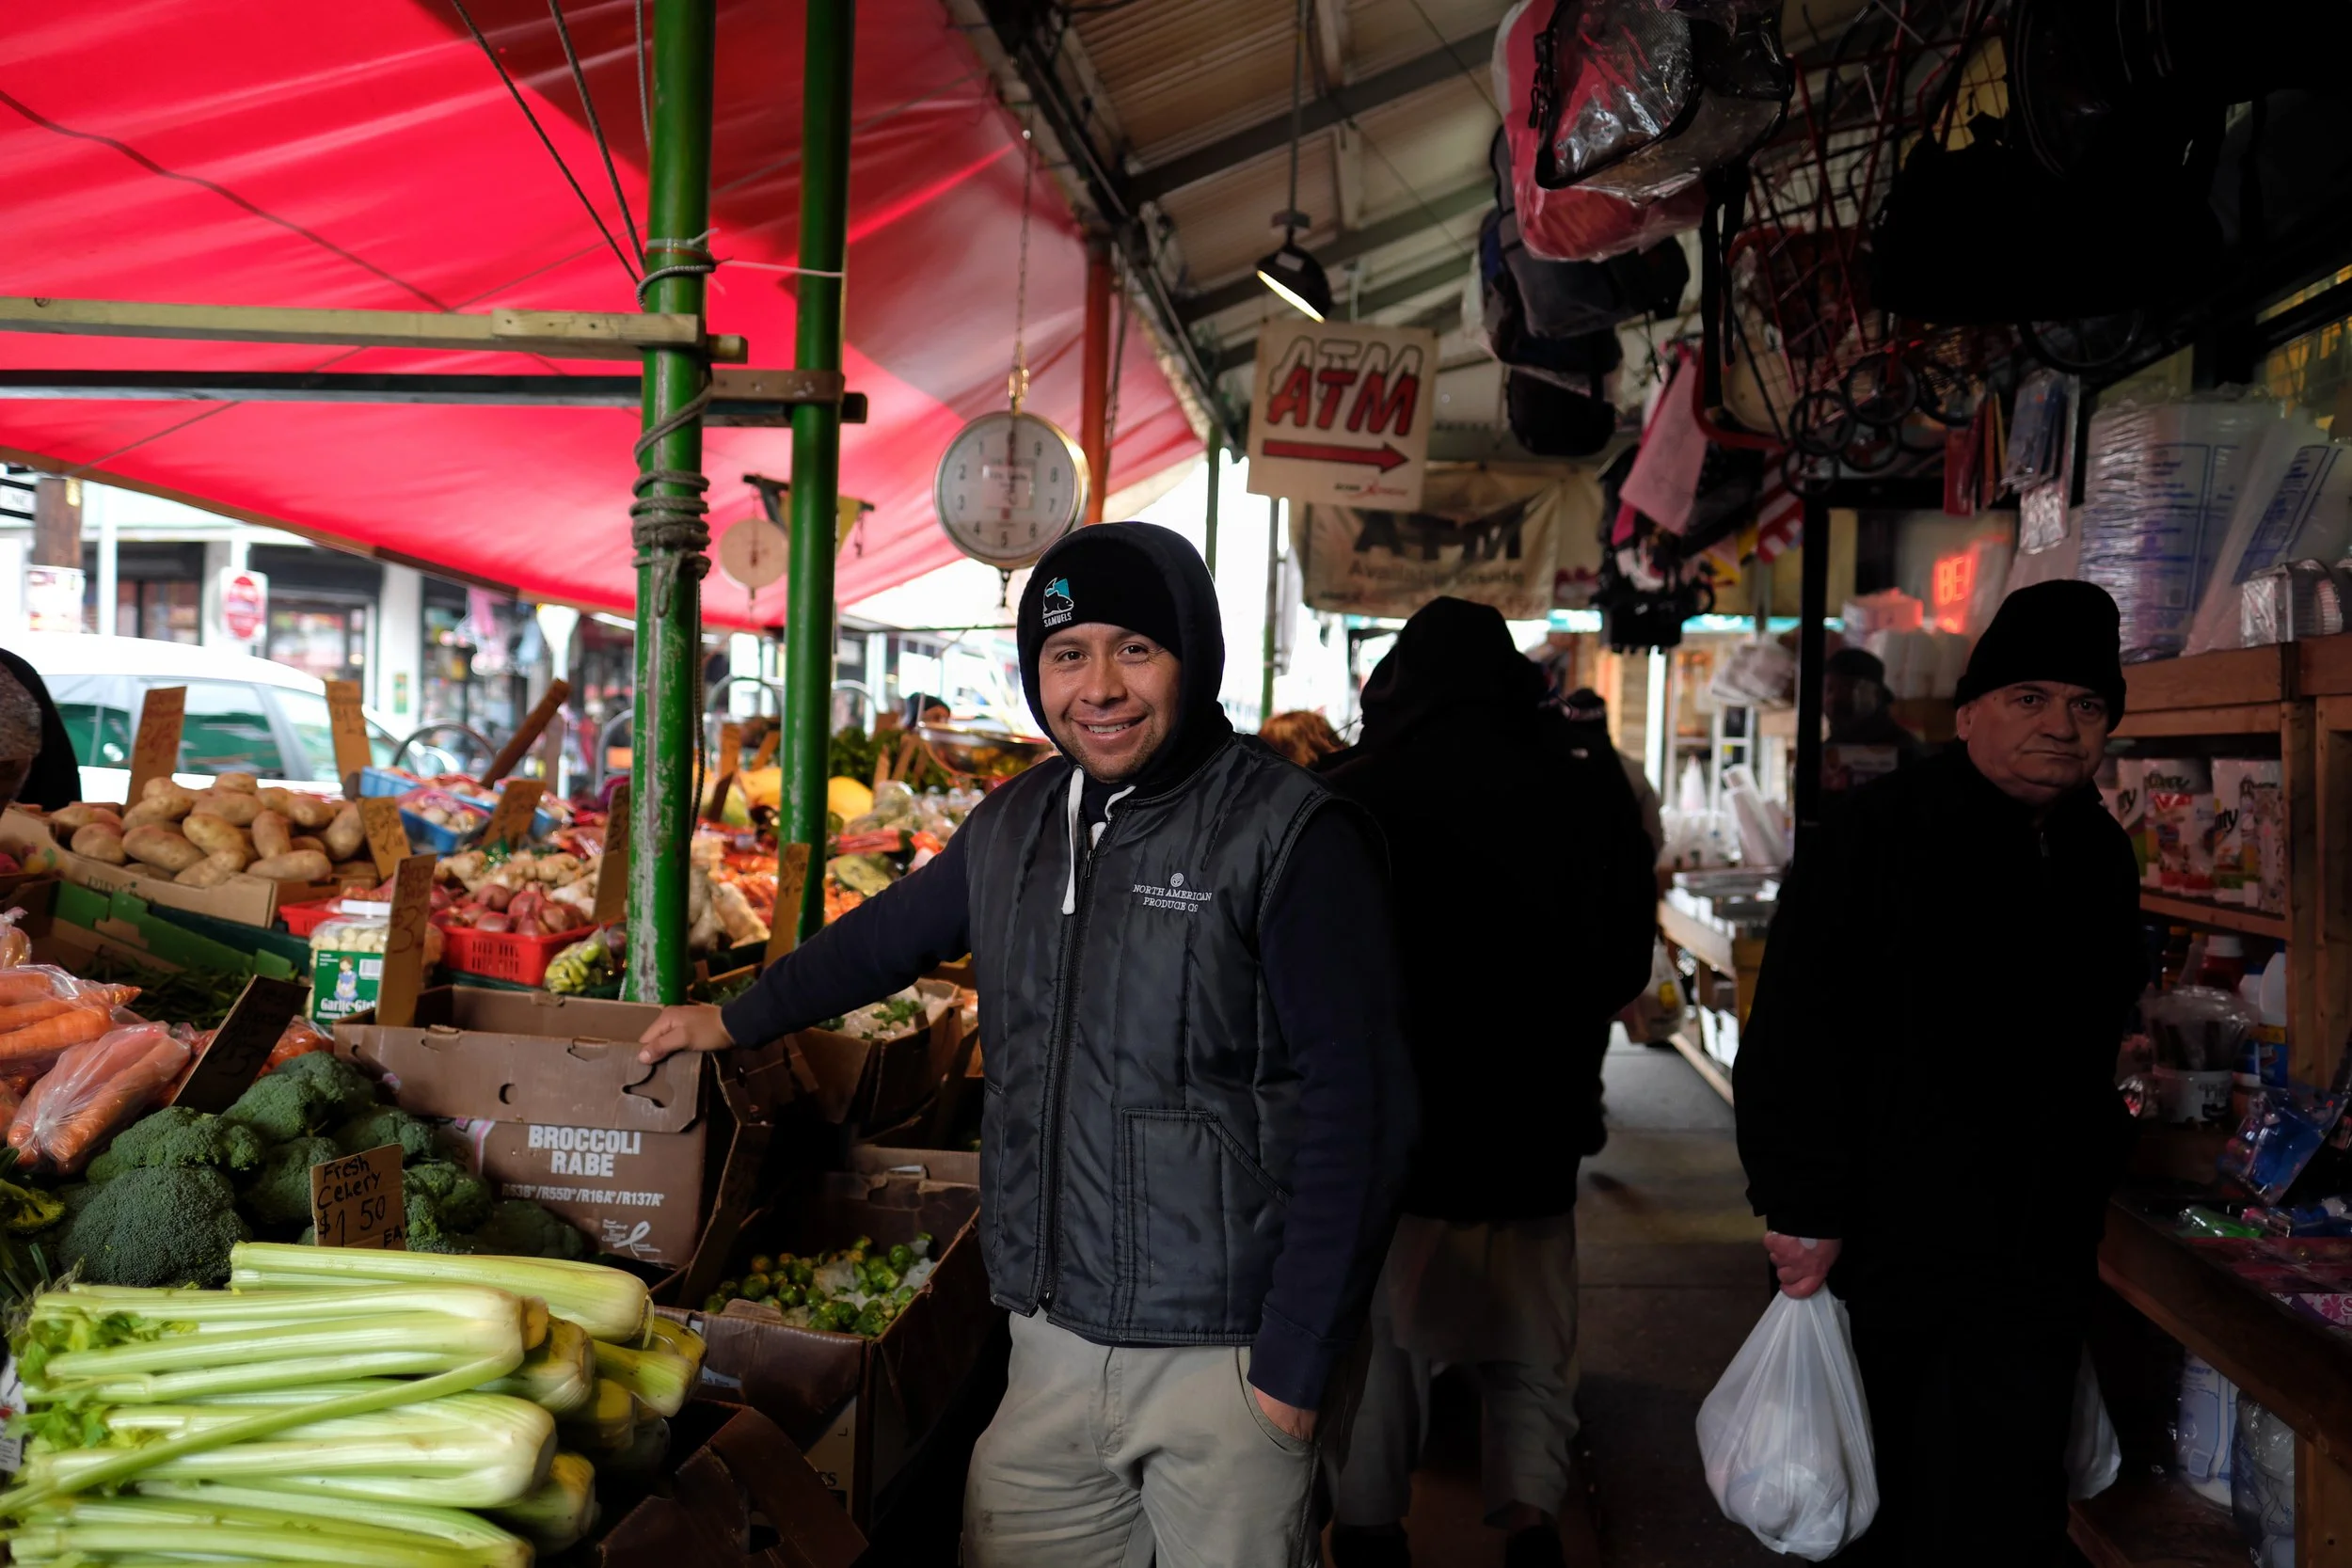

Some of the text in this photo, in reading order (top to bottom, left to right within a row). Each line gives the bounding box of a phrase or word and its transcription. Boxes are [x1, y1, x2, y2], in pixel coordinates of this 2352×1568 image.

[1267, 336, 1422, 437] ATM
[973, 521, 981, 535] 4
[1000, 531, 1008, 547] 5
[1044, 611, 1072, 627] SAMUELS
[1133, 884, 1212, 901] NORTH AMERICAN
[1143, 896, 1186, 911] PRODUCE
[321, 998, 352, 1013] Garlic
[528, 1124, 641, 1155] BROCCOLI
[324, 1154, 370, 1183] Fresh
[551, 1150, 614, 1177] RABE
[383, 1225, 403, 1248] EA
